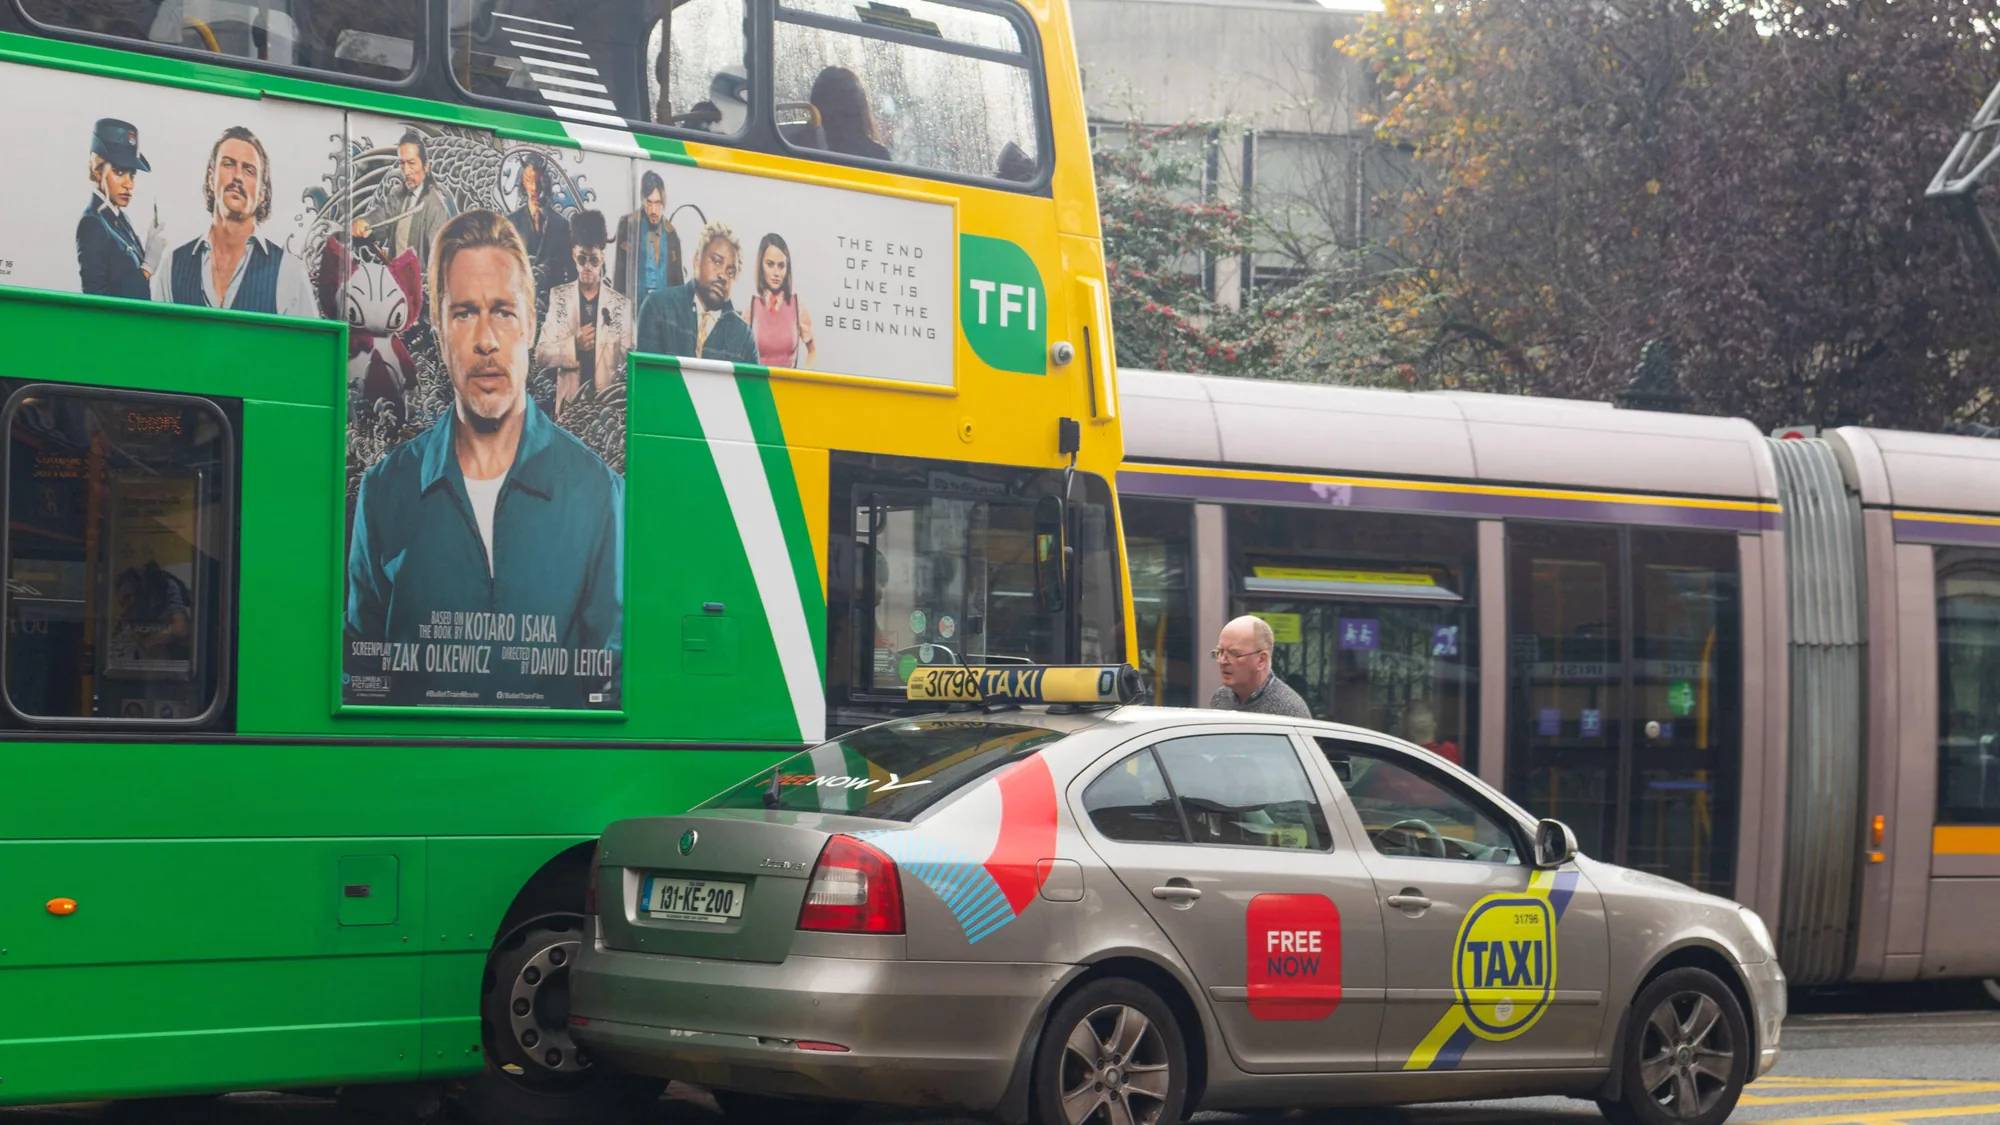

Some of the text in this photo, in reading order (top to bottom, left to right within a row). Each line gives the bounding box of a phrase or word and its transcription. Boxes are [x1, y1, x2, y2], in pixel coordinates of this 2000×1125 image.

[836, 236, 924, 259] THE END
[5, 260, 13, 268] 16
[846, 257, 916, 278] OF THE
[844, 277, 918, 298] LINE IS
[833, 297, 928, 319] JUST THE
[969, 278, 1036, 331] TFI
[825, 315, 937, 340] BEGINNING
[431, 610, 464, 626] BASED ON
[464, 612, 557, 643] KOTARO ISAKA
[419, 625, 463, 640] THE BOOK BY
[352, 642, 391, 658] SCREENPLAY
[392, 643, 492, 675] ZAK OLKEWICZ
[501, 646, 530, 662] DIRECTED
[382, 657, 391, 671] BY
[521, 661, 530, 675] BY
[530, 647, 613, 677] DAVID LEITCH
[925, 670, 1041, 698] 31796 TAXI
[659, 885, 734, 914] 131-KE-200
[1514, 914, 1539, 925] 31796
[1267, 931, 1322, 953] FREE
[1267, 956, 1320, 977] NOW
[1467, 939, 1543, 988] TAXI
